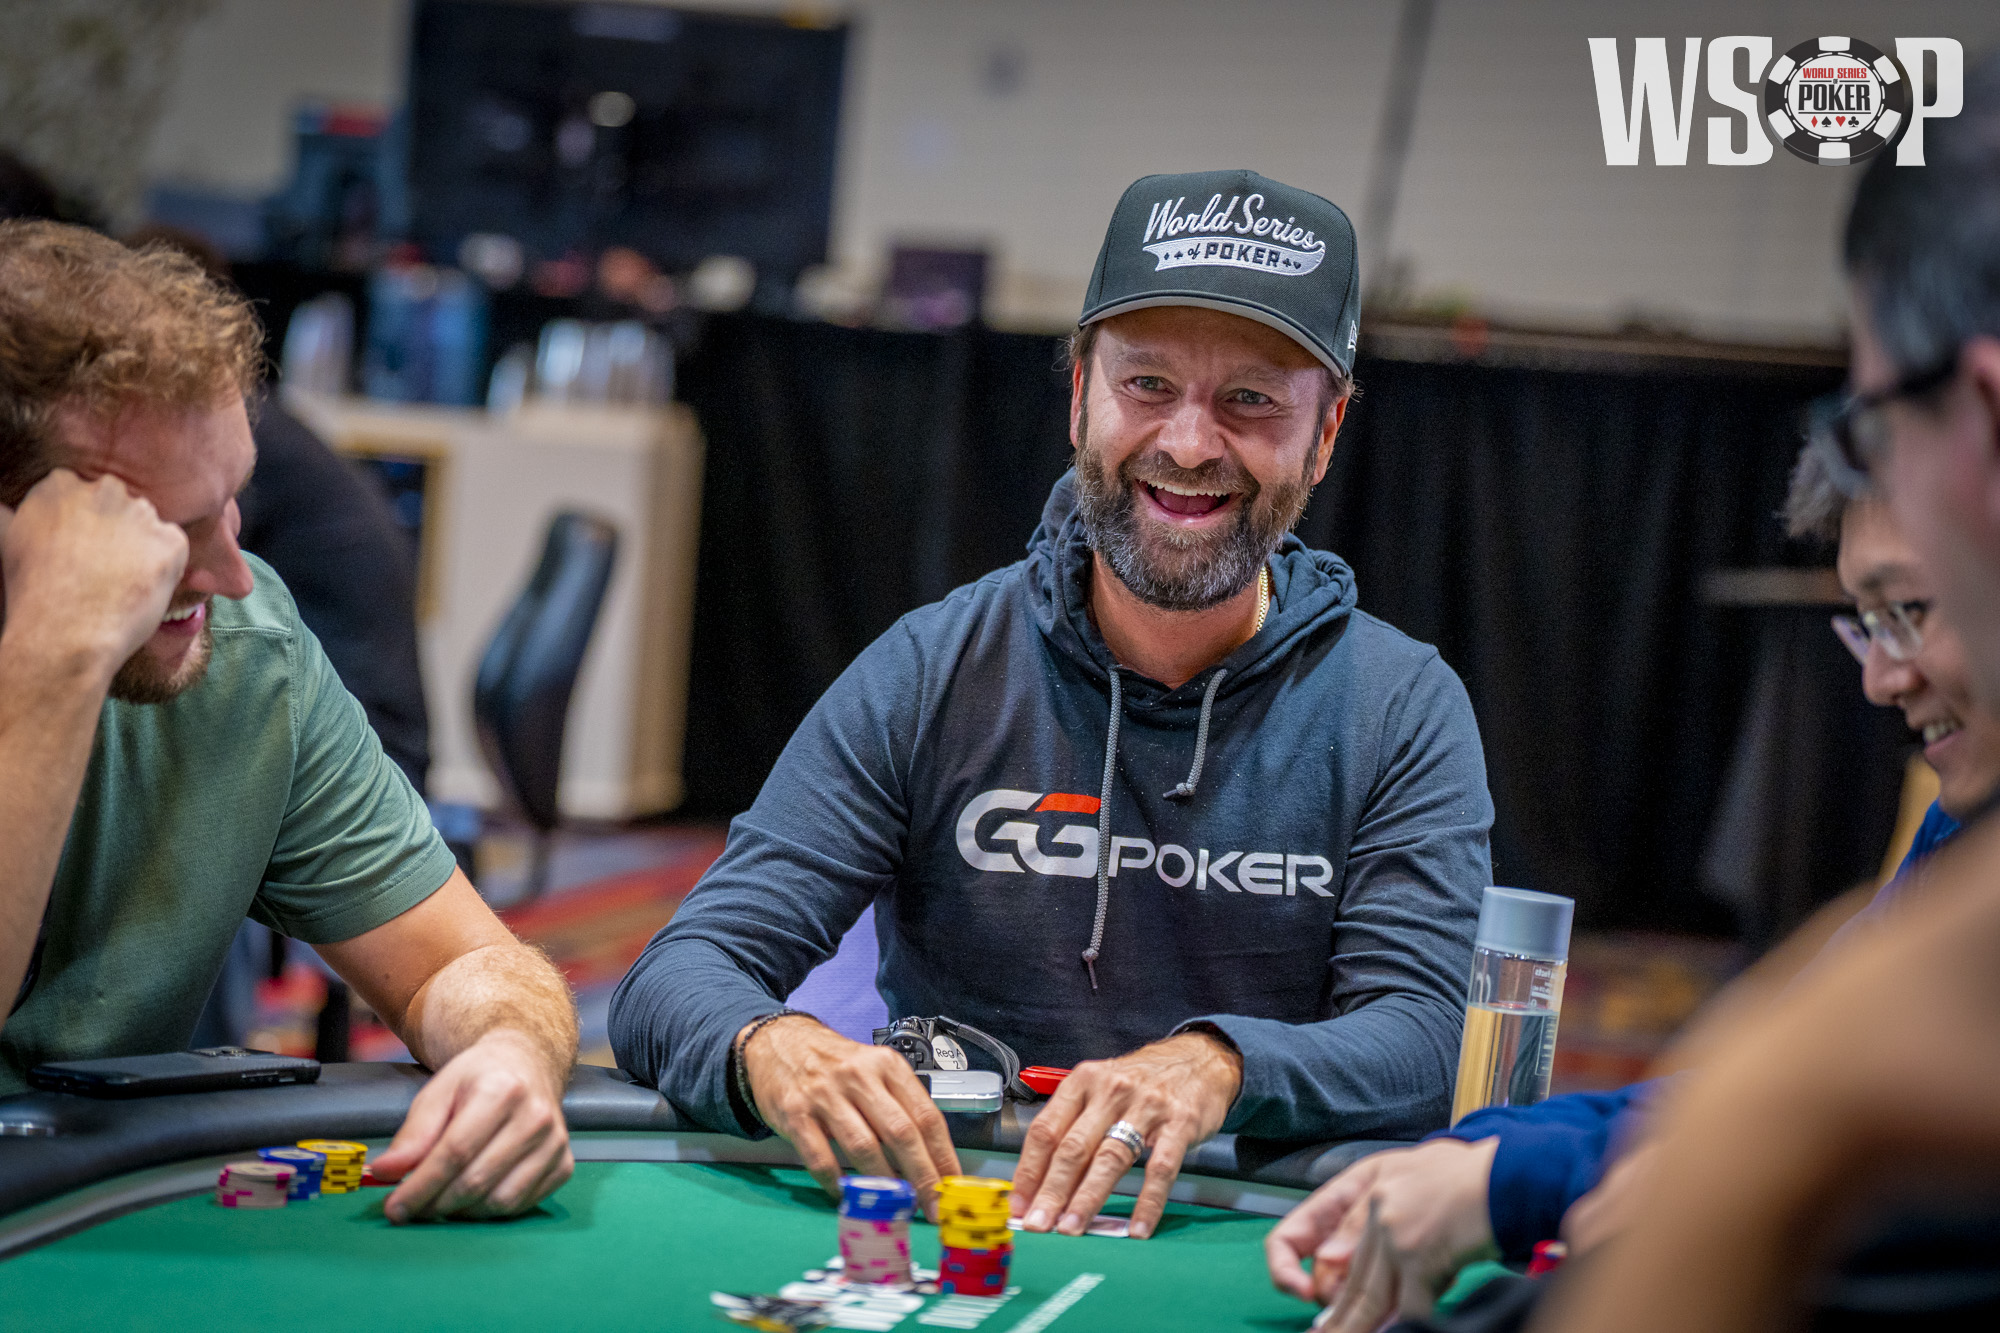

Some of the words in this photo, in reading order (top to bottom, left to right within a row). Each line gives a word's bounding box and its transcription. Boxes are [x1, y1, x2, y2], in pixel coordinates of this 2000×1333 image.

[1143, 193, 1240, 243] World
[1234, 193, 1326, 250] Series
[1188, 243, 1201, 260] of
[1204, 242, 1280, 267] POKER
